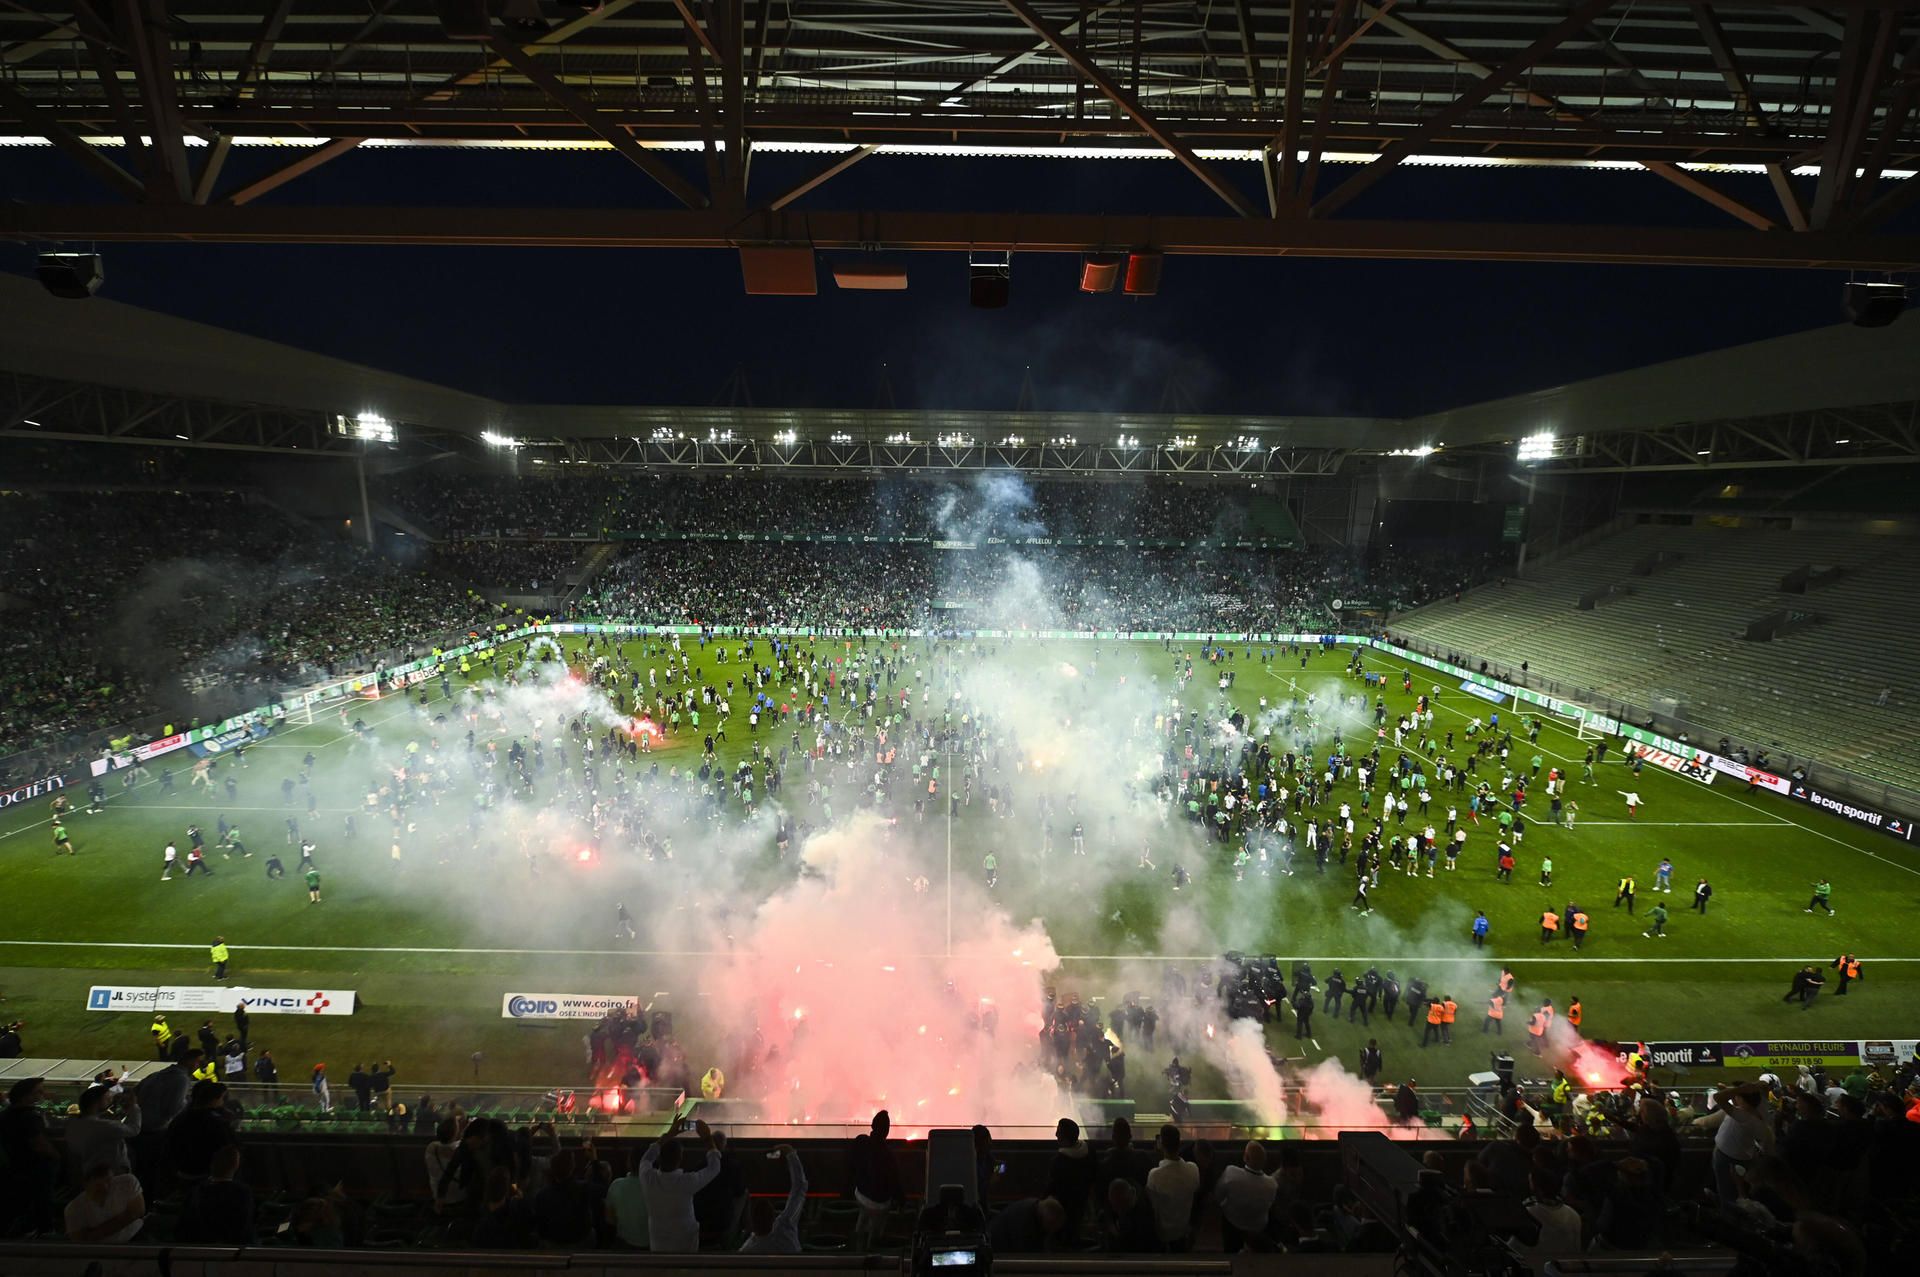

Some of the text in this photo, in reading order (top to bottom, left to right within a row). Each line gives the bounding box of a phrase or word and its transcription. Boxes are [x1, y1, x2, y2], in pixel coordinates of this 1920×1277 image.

[1421, 656, 1439, 669] ASSE
[1454, 666, 1474, 680] ASSE
[1493, 680, 1516, 697] ASSE
[1536, 695, 1564, 714] ASSE
[1652, 735, 1690, 758] ASSE
[1810, 791, 1883, 826] le coq sportif
[112, 991, 123, 1001] JL
[126, 991, 176, 1004] systems
[241, 998, 301, 1007] VINCI
[562, 1000, 634, 1009] www.coiro.fr
[1768, 1043, 1845, 1052] REYNAUD FLEURS
[1653, 1047, 1693, 1065] sportif
